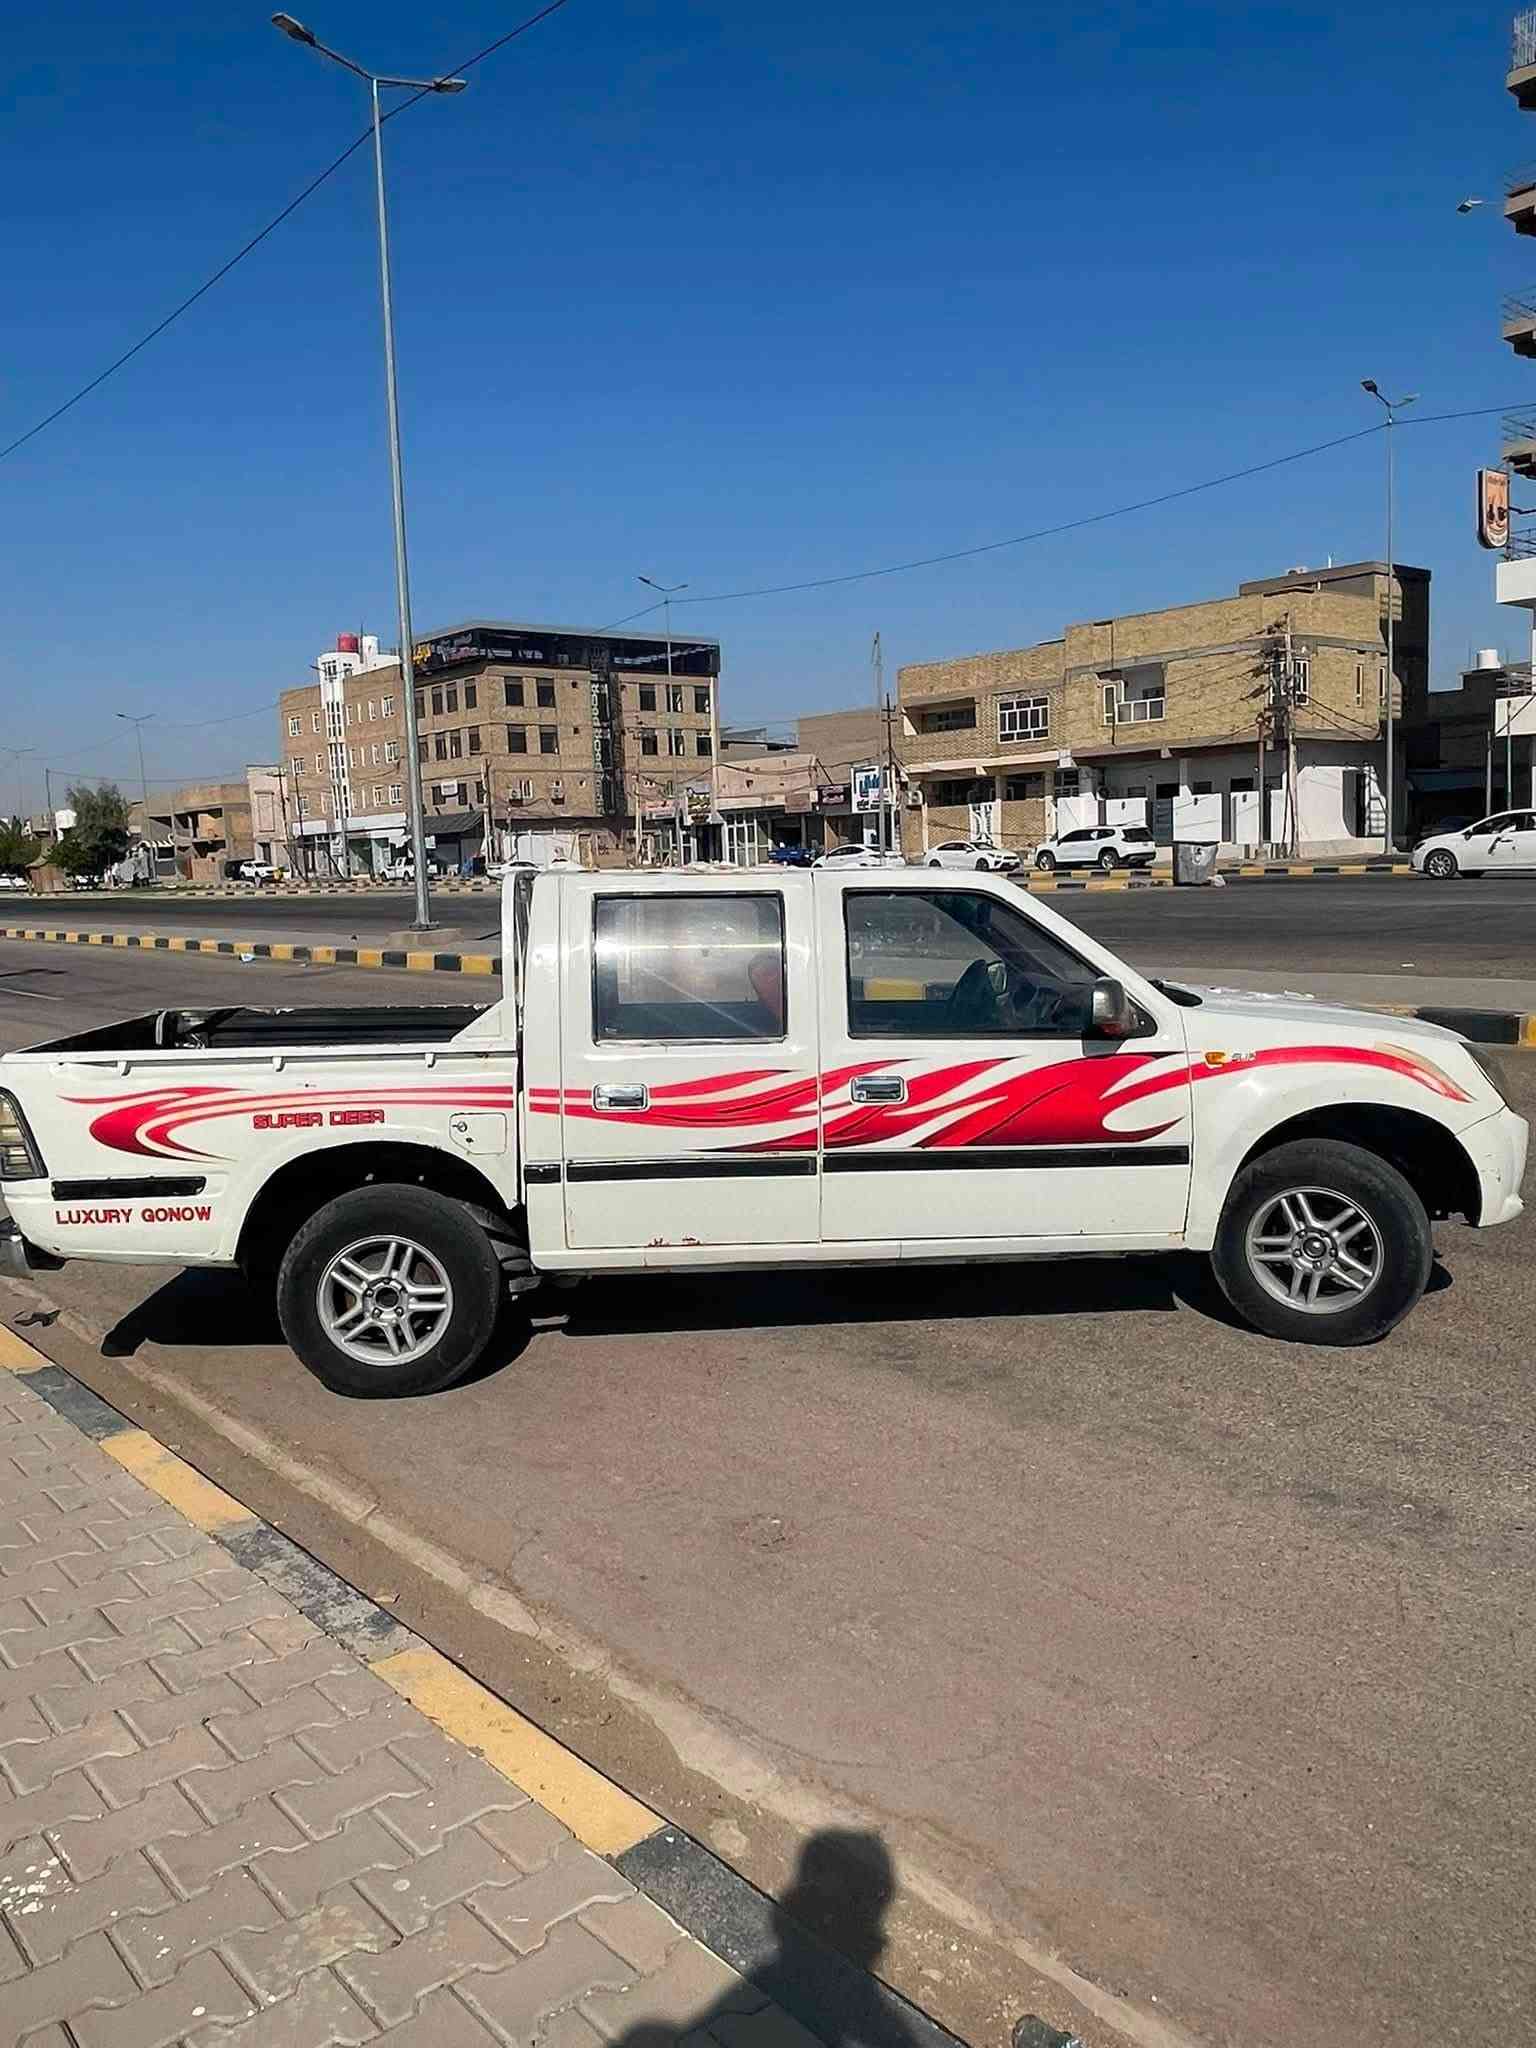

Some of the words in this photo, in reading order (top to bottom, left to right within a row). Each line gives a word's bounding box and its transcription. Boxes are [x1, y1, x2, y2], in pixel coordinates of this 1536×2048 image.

[253, 1112, 323, 1129] SUPER
[329, 1109, 385, 1126] DEER
[55, 1208, 133, 1225] LUXURY
[141, 1206, 212, 1223] GONOW
